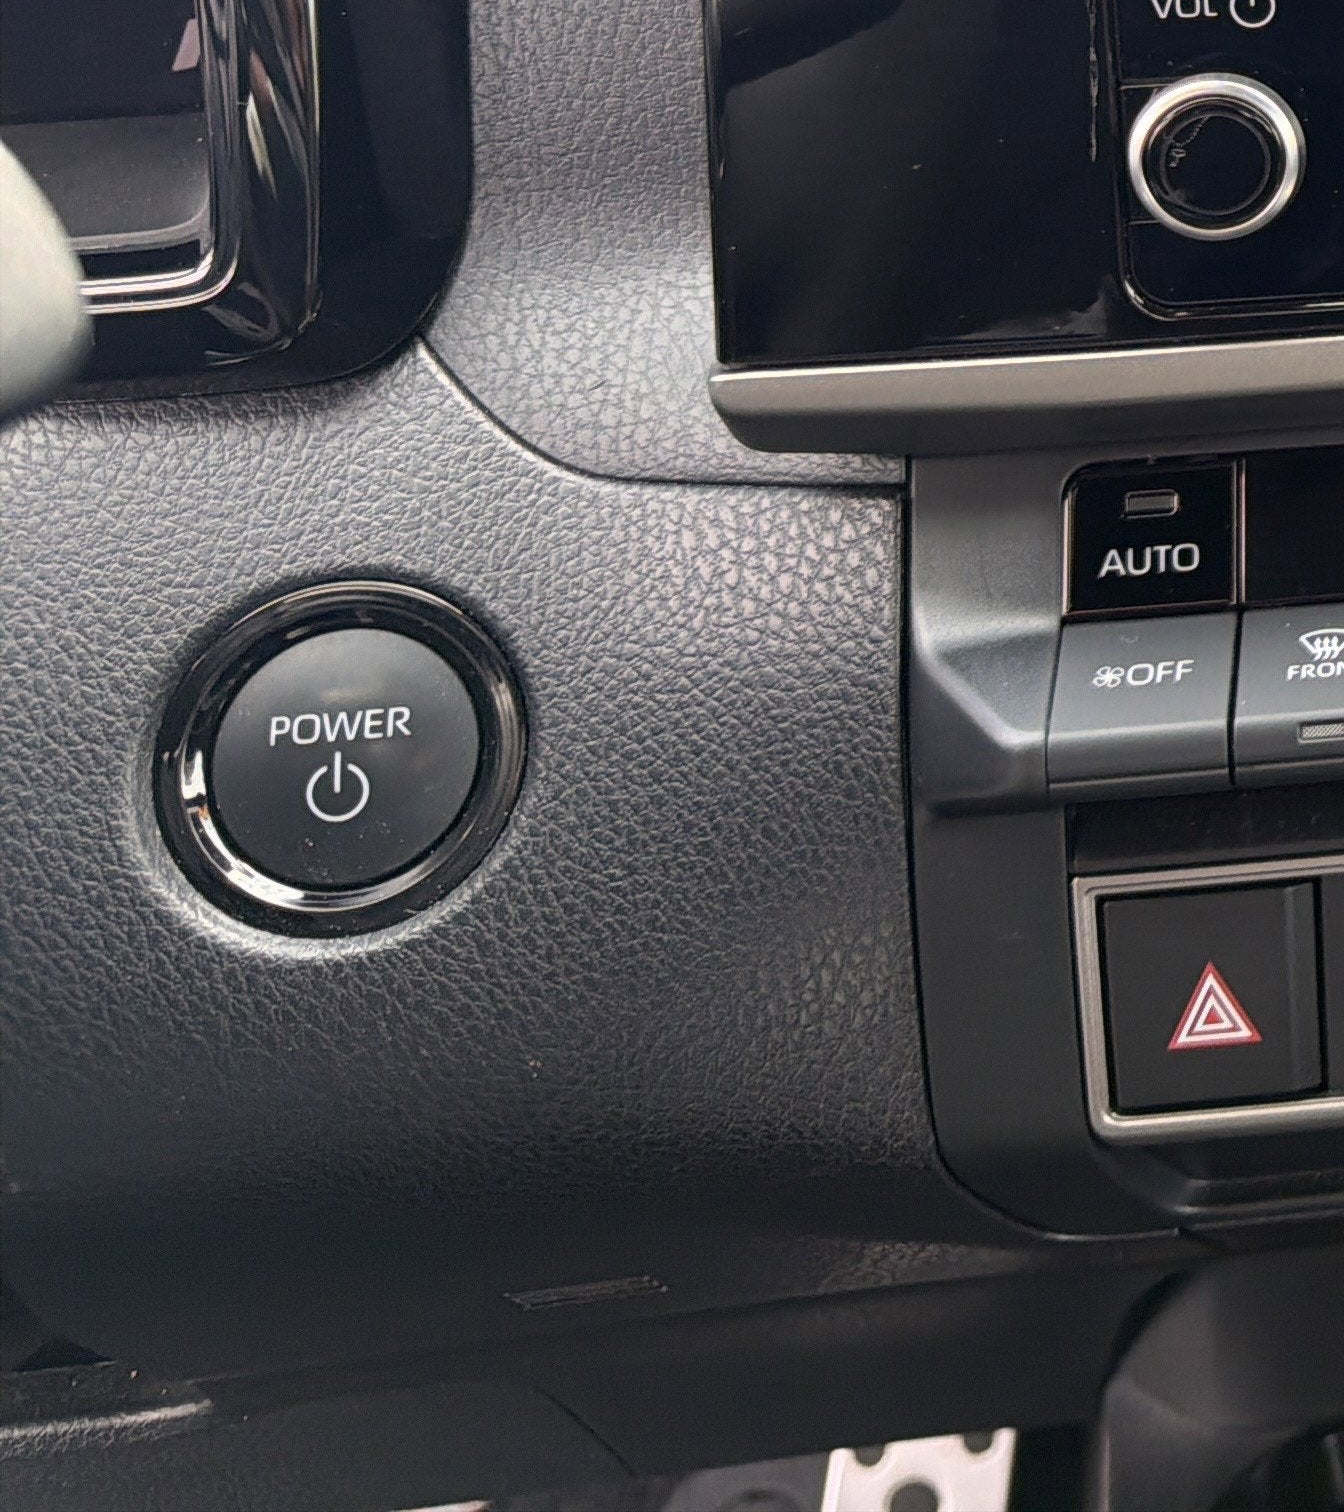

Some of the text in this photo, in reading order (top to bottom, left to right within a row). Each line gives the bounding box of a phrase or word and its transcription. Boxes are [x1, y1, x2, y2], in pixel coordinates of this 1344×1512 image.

[1099, 543, 1200, 578] AUTO
[1125, 659, 1195, 686] OFF
[269, 706, 411, 747] POWER
